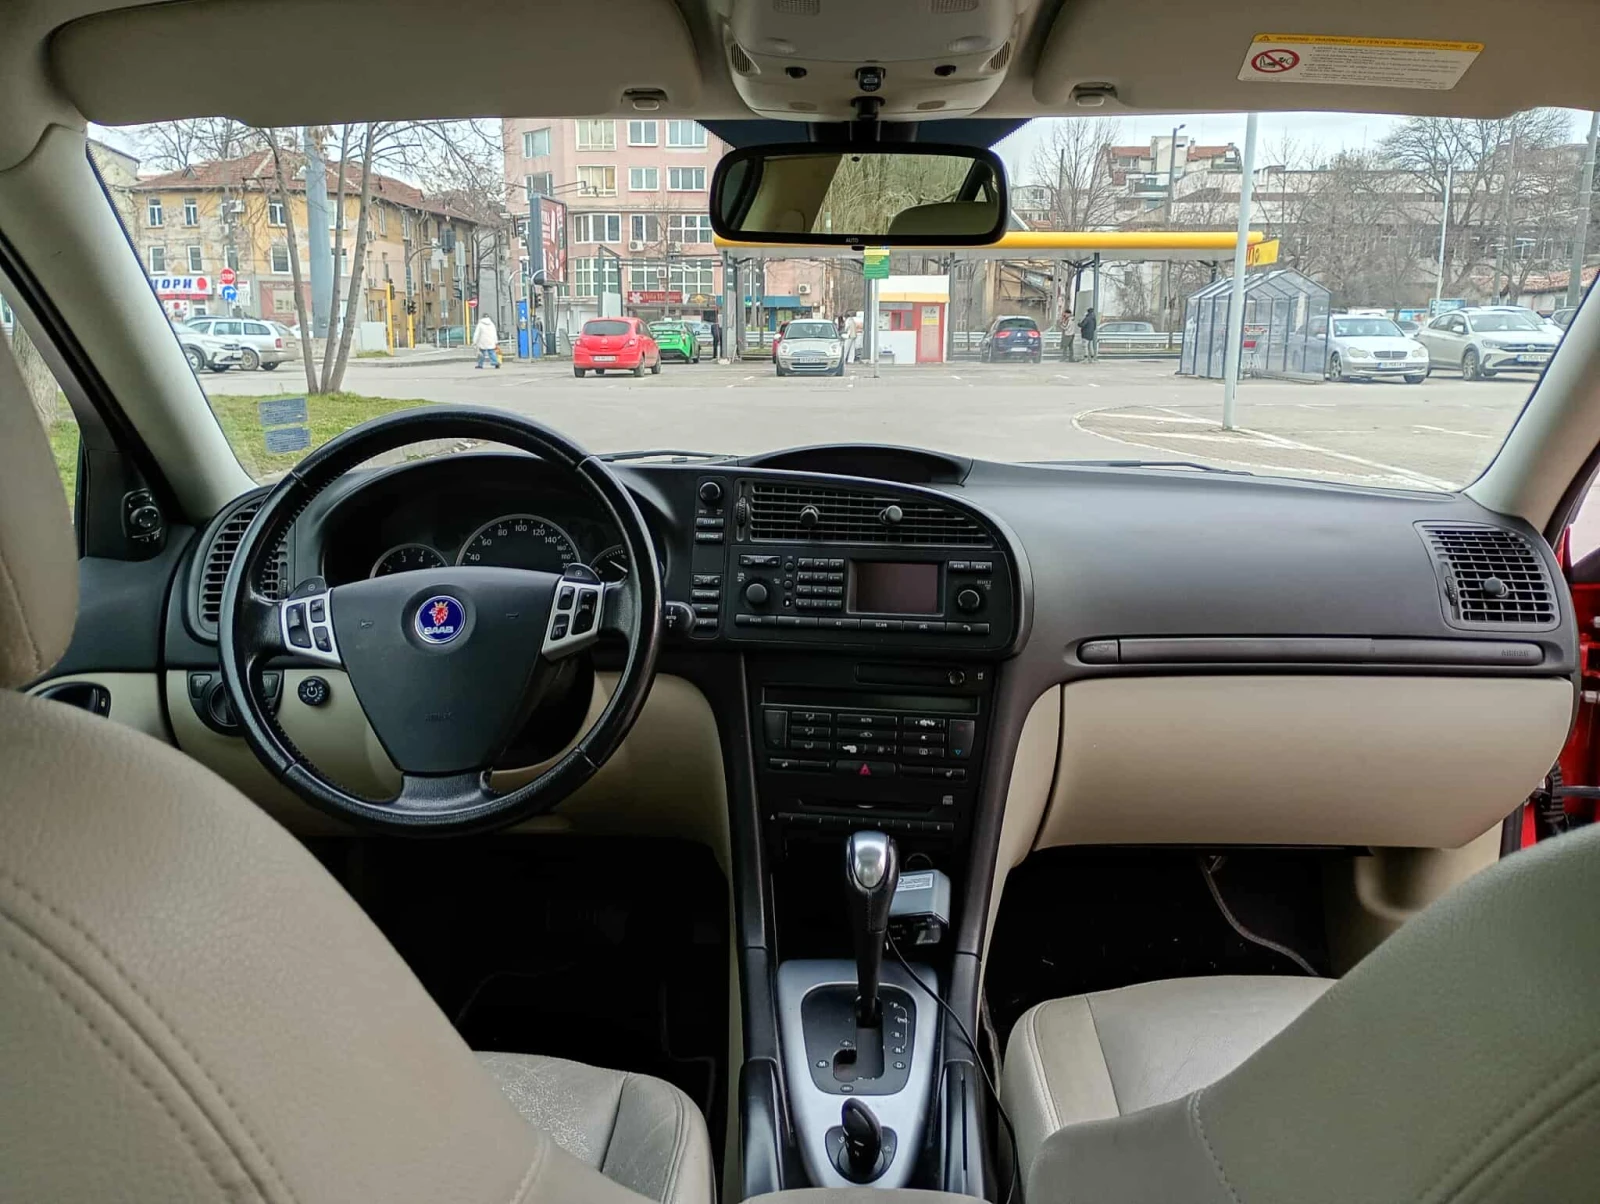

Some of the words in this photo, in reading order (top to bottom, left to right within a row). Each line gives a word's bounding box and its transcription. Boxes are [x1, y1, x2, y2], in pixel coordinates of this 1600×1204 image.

[514, 524, 528, 532] 100
[532, 528, 546, 536] 120
[544, 536, 557, 544] 140
[424, 625, 454, 635] SAAB
